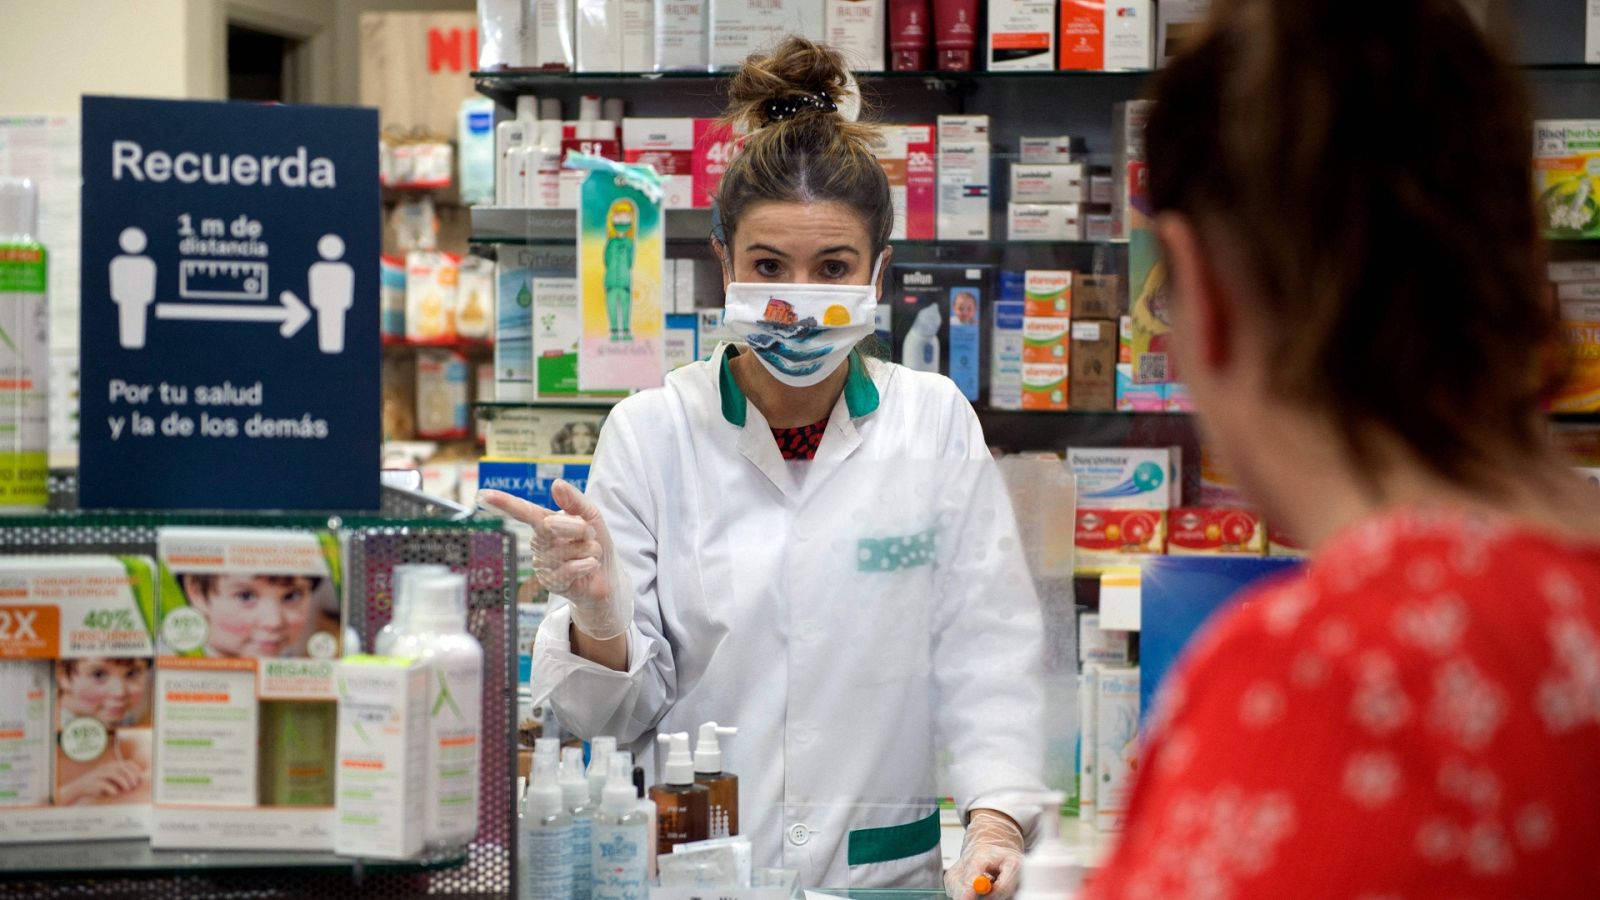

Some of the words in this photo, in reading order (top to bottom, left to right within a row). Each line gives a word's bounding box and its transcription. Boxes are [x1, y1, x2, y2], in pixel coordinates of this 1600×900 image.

[112, 140, 336, 188] Recuerda
[178, 214, 192, 236] 1
[201, 219, 225, 238] m
[230, 214, 263, 239] de
[178, 236, 269, 258] distancia
[903, 271, 933, 285] BRAUN
[109, 380, 153, 404] Por
[160, 382, 188, 405] tu
[194, 382, 263, 406] salud
[107, 415, 126, 441] y
[131, 411, 155, 436] la
[161, 412, 194, 437] de
[201, 413, 239, 438] los
[245, 412, 330, 439] demás
[83, 609, 135, 629] 40%
